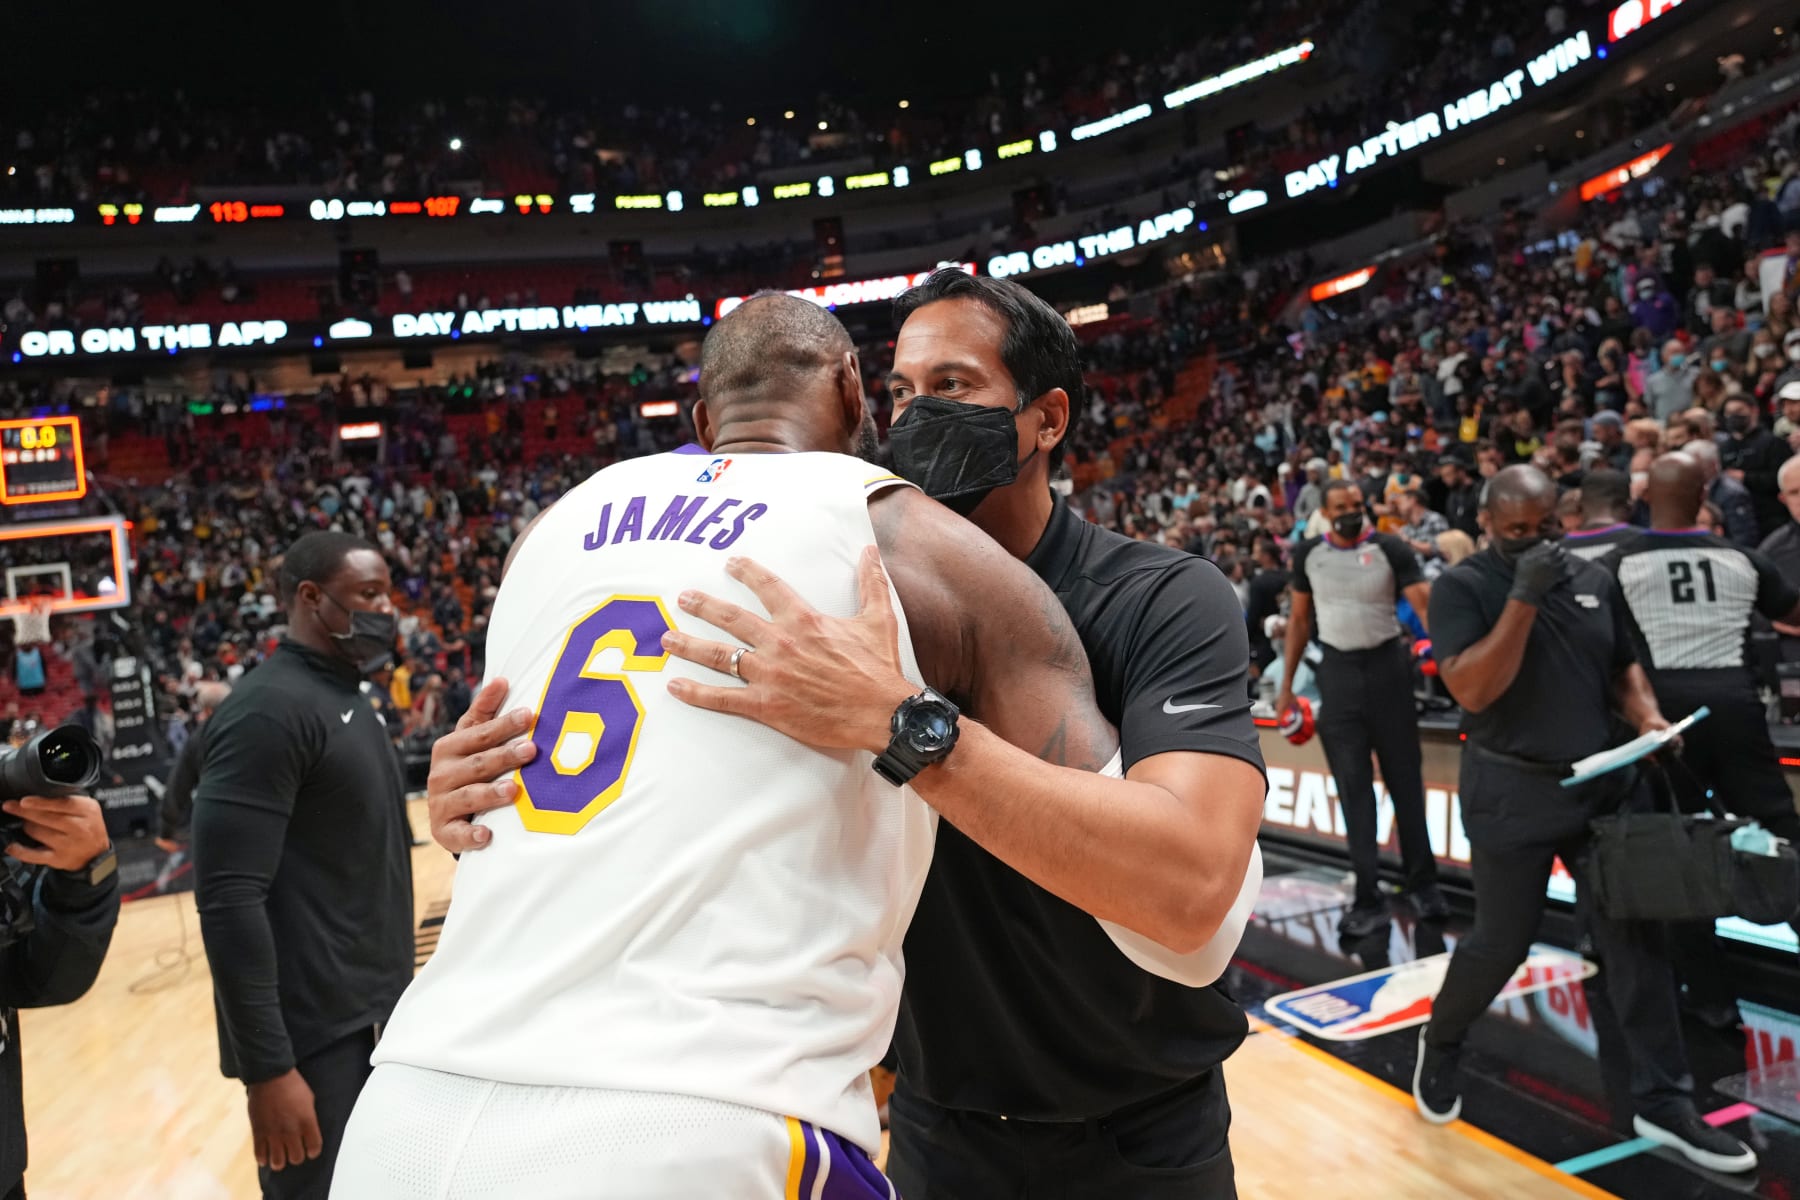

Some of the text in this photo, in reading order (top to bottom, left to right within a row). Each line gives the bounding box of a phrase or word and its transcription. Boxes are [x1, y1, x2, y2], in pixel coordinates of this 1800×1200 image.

[1285, 30, 1591, 198] DAY AFTER HEAT WIN
[210, 201, 248, 222] 113
[310, 199, 344, 220] 0.0
[424, 196, 459, 217] 107
[988, 252, 1030, 280] OR
[1033, 241, 1075, 270] ON
[1078, 226, 1134, 259] THE
[1137, 207, 1194, 244] APP
[20, 320, 287, 357] OR ON THE APP
[392, 299, 701, 337] DAY AFTER HEAT WIN
[20, 426, 57, 449] 0.0
[583, 494, 767, 551] JAMES
[1668, 558, 1716, 604] 21
[513, 593, 676, 835] 6
[1264, 767, 1347, 836] EAT
